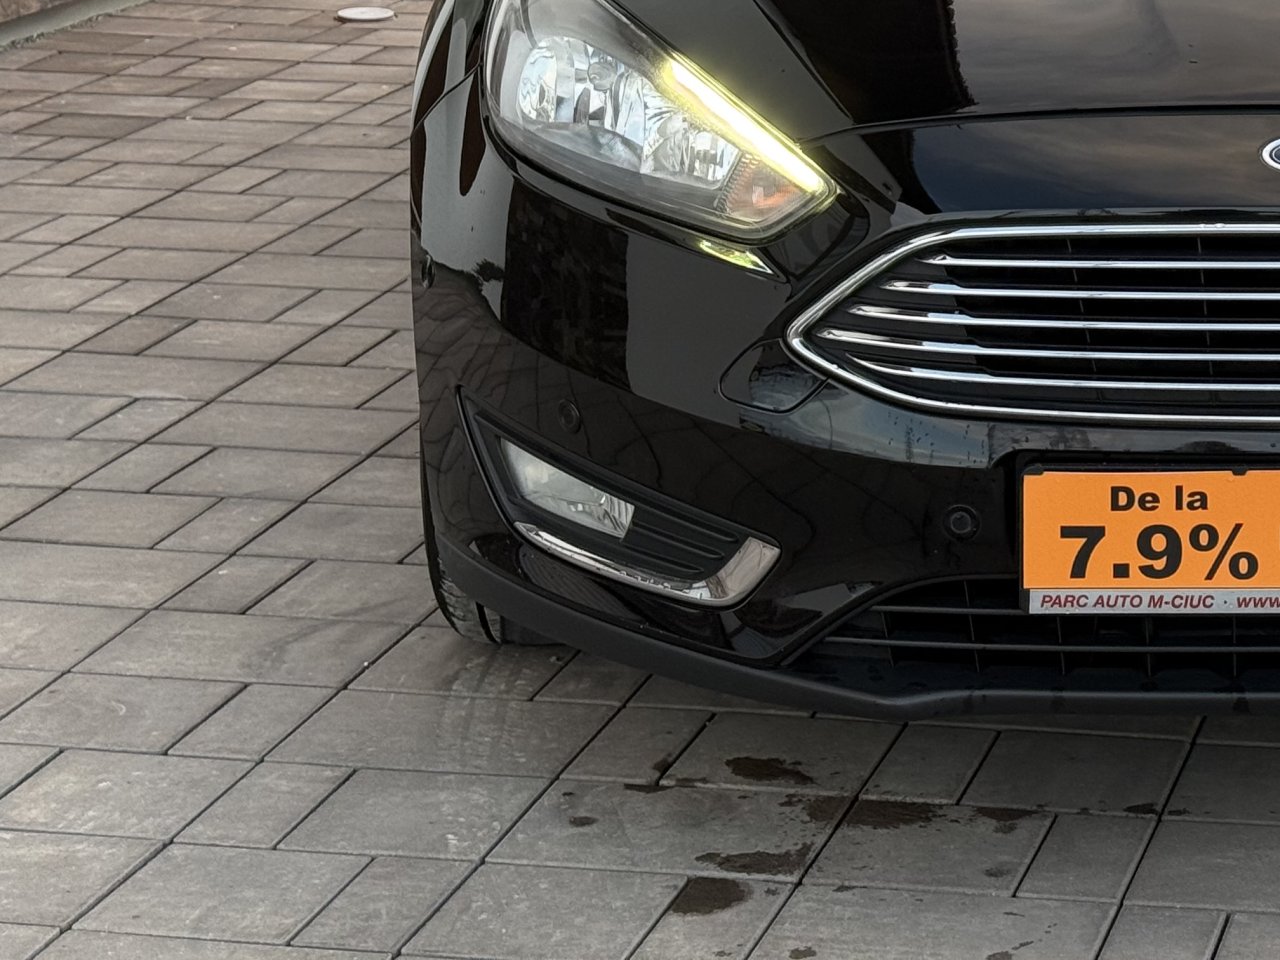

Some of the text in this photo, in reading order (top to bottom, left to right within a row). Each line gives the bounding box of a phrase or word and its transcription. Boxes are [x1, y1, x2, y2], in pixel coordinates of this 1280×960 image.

[1110, 485, 1209, 511] De la
[1059, 523, 1258, 581] 7.9%
[1040, 595, 1089, 608] PARC
[1092, 595, 1143, 608] AUTO
[1147, 594, 1215, 608] M-CIUC
